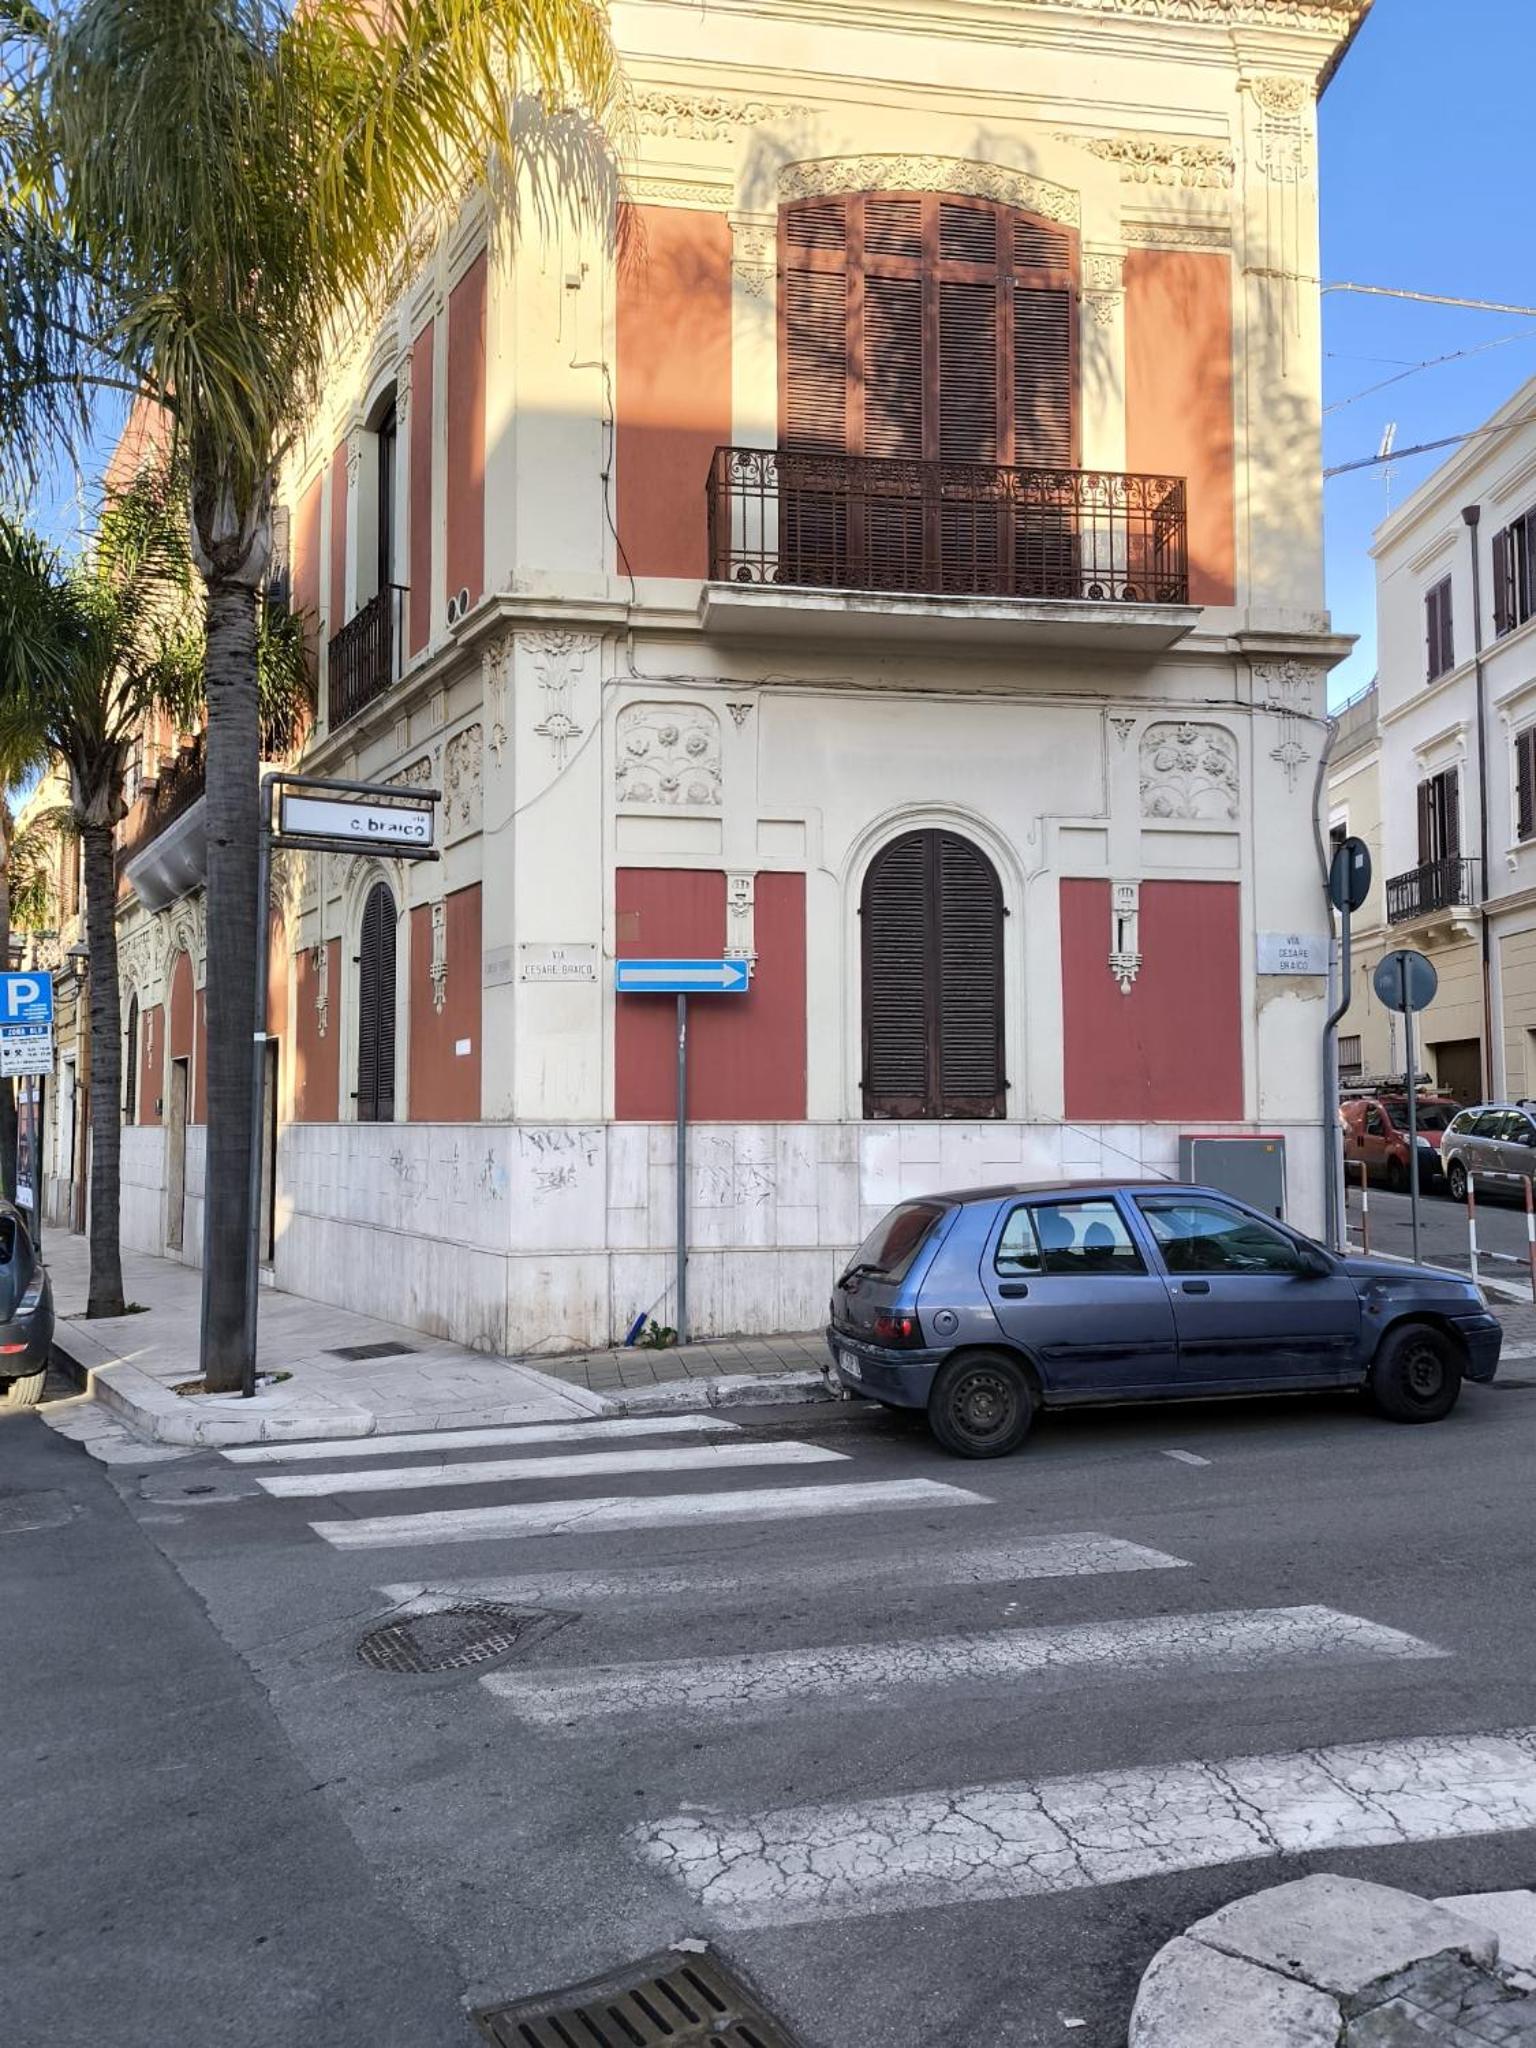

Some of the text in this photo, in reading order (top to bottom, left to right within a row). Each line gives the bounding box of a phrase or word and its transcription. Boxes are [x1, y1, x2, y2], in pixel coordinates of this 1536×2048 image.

[368, 818, 425, 836] braico
[1287, 936, 1300, 945] VIA
[551, 950, 565, 959] VIA
[1279, 949, 1309, 958] CESARE
[1280, 961, 1309, 970] BRAICO
[7, 978, 40, 1017] P
